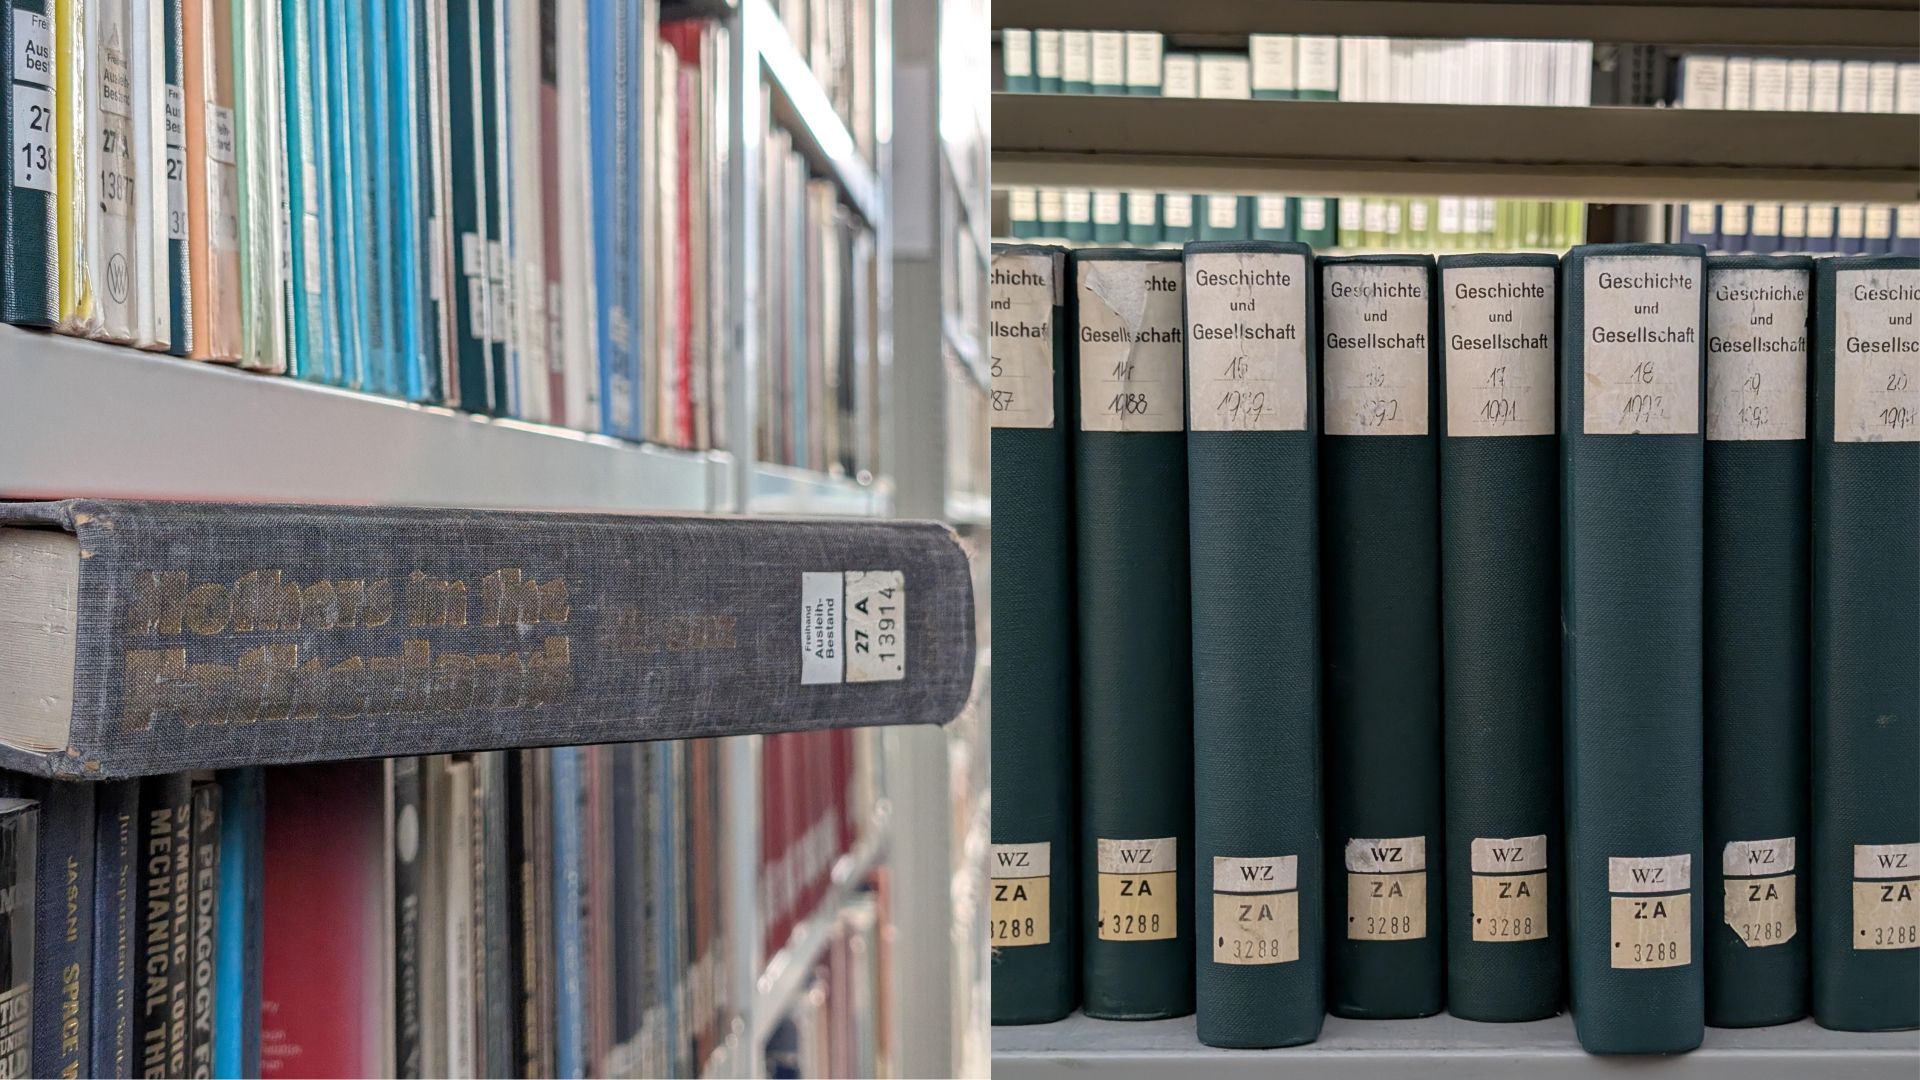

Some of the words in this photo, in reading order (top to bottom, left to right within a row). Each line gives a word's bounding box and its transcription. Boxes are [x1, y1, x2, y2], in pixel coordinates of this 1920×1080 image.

[30, 105, 51, 133] 27
[103, 129, 115, 152] 27
[1196, 269, 1291, 287] Geschichte
[1599, 272, 1692, 289] Geschichte
[1331, 282, 1421, 298] Geschichte
[1456, 283, 1544, 299] Geschichte
[1716, 285, 1804, 300] Geschichte
[1230, 299, 1255, 312] und
[1634, 302, 1659, 314] und
[1364, 310, 1387, 322] und
[1489, 310, 1512, 323] und
[1750, 313, 1773, 325] und
[1889, 313, 1912, 325] und
[1193, 323, 1296, 340] Gesellschaft
[1592, 327, 1694, 343] Gesellschaft
[1327, 333, 1425, 349] Gesellschaft
[1452, 334, 1548, 350] Gesellschaft
[1709, 337, 1805, 353] Gesellschaft
[855, 597, 869, 615] A
[815, 598, 824, 659] Ausleih-
[826, 598, 834, 659] Bestand
[878, 587, 896, 662] 13914
[855, 630, 869, 653] 27
[118, 815, 130, 857] Jura
[997, 852, 1030, 867] WZ
[1120, 849, 1153, 864] WZ
[1371, 847, 1402, 863] WZ
[1492, 847, 1523, 862] WZ
[1878, 854, 1908, 868] WZ
[1240, 866, 1274, 882] WZ
[1632, 868, 1664, 884] WZ
[172, 804, 190, 965] SYMBOLIC
[67, 856, 78, 943] JASANI
[146, 808, 172, 1016] MECHANICAL
[116, 864, 129, 981] Separatism
[1113, 914, 1159, 934] 3288
[1367, 915, 1410, 934] 3288
[1489, 917, 1532, 936] 3288
[1743, 921, 1782, 941] 3288
[195, 845, 214, 1031] PEDAGOGY
[1876, 925, 1916, 945] 3288
[1233, 938, 1279, 959] 3288
[1634, 942, 1677, 962] 3288
[62, 962, 80, 1053] SPACE
[116, 989, 125, 1009] in
[171, 981, 186, 1074] LOGIC
